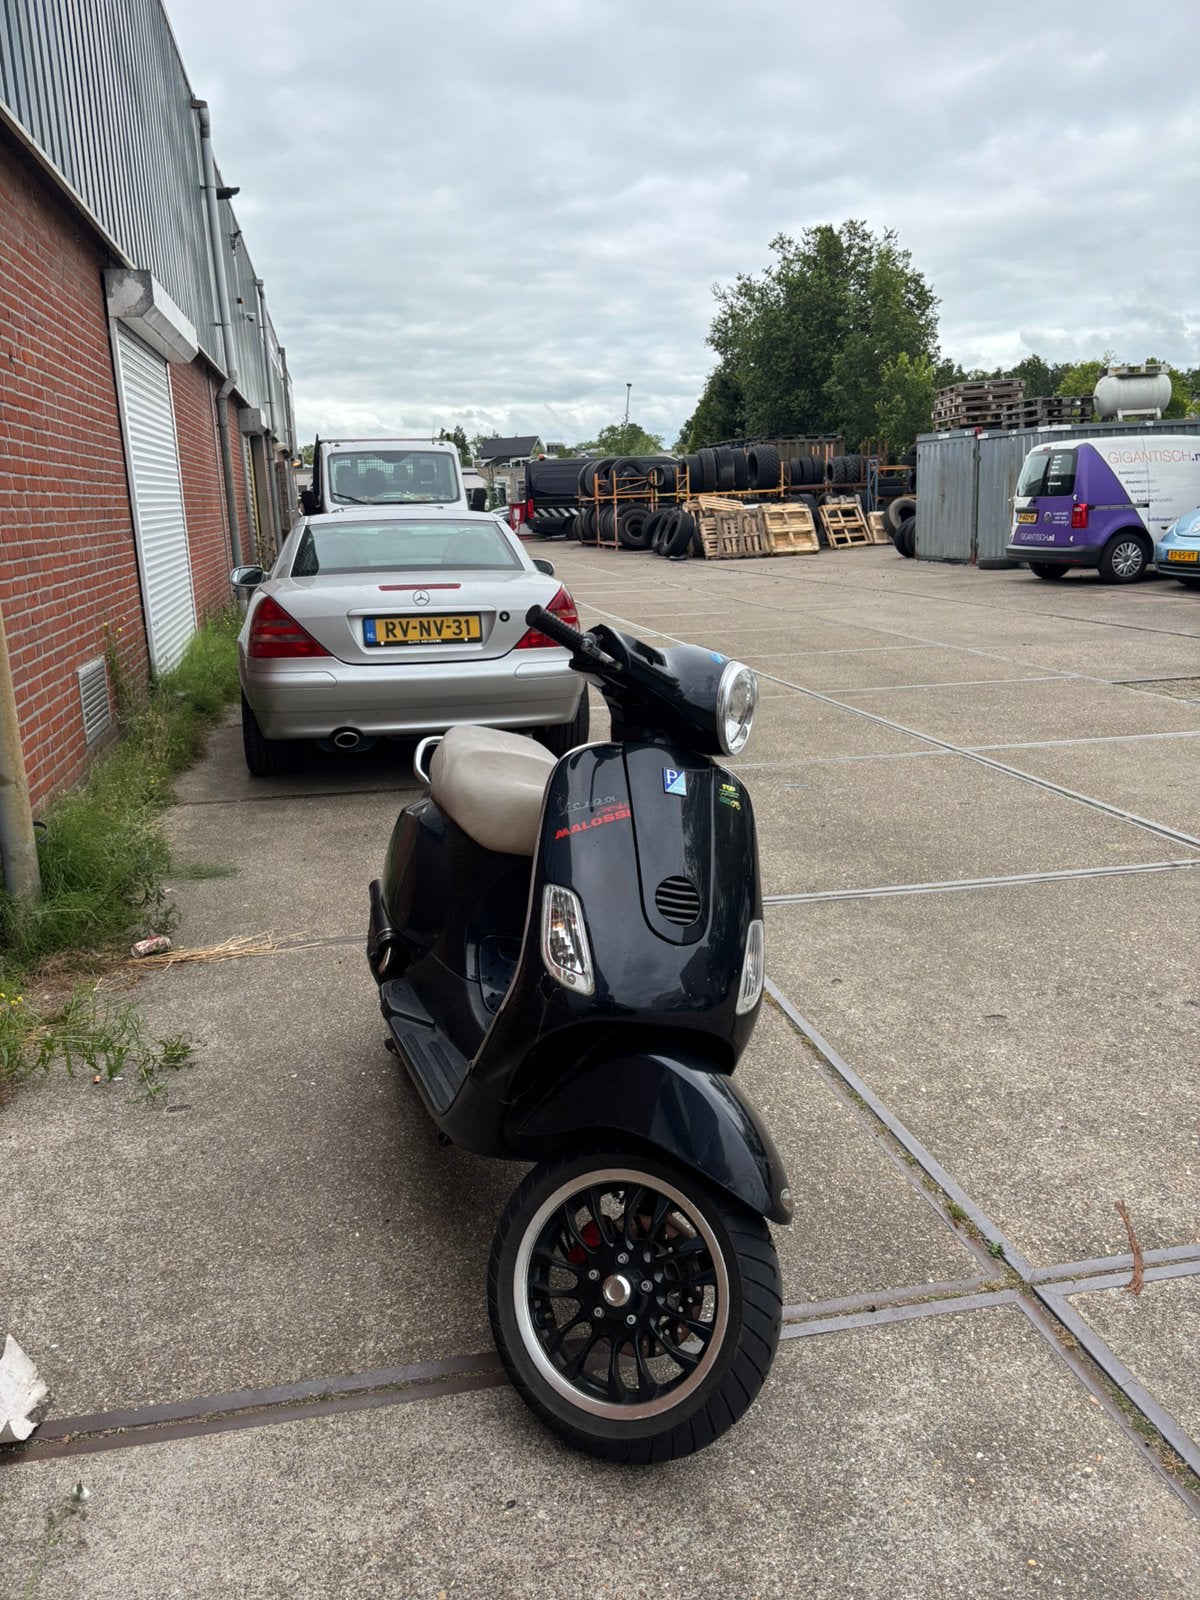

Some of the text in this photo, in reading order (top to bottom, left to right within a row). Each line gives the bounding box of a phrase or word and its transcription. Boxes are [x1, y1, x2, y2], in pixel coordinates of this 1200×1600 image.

[385, 619, 471, 639] RV-NV-31
[666, 769, 678, 784] P
[555, 808, 631, 840] MALOSSI
